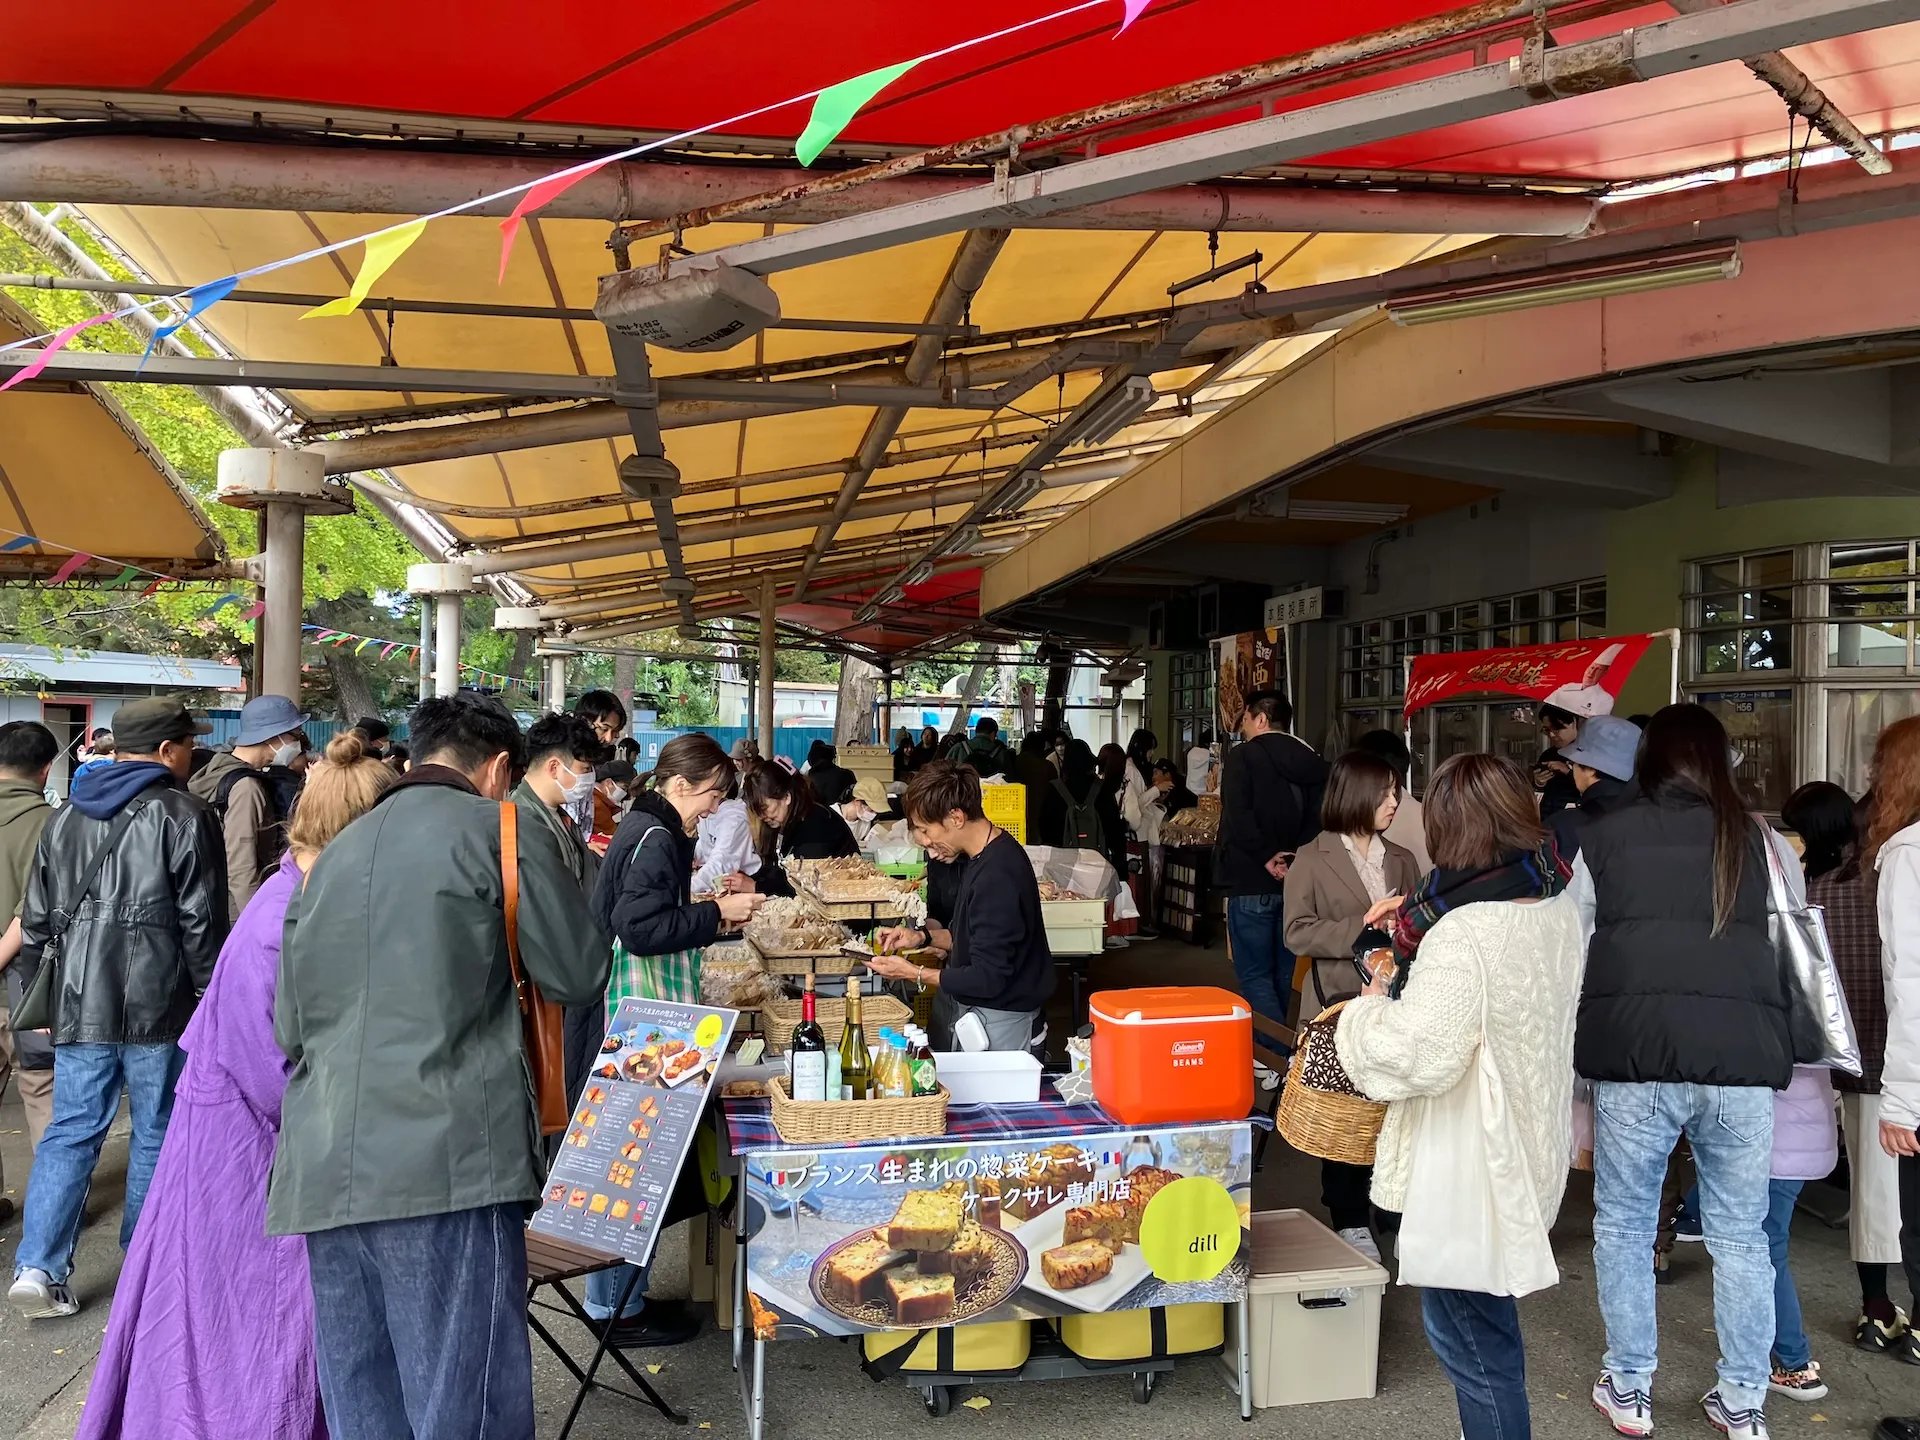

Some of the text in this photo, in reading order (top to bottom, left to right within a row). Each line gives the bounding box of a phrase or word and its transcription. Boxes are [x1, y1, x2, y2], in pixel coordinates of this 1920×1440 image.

[1267, 593, 1318, 622] 本館投票所
[1736, 702, 1753, 712] H56
[1172, 1057, 1204, 1067] BEAMS
[787, 1146, 1099, 1190] フランス生まれの惣菜ケーキ
[960, 1177, 1132, 1214] ケークサレ専門店
[1188, 1233, 1219, 1254] dill
